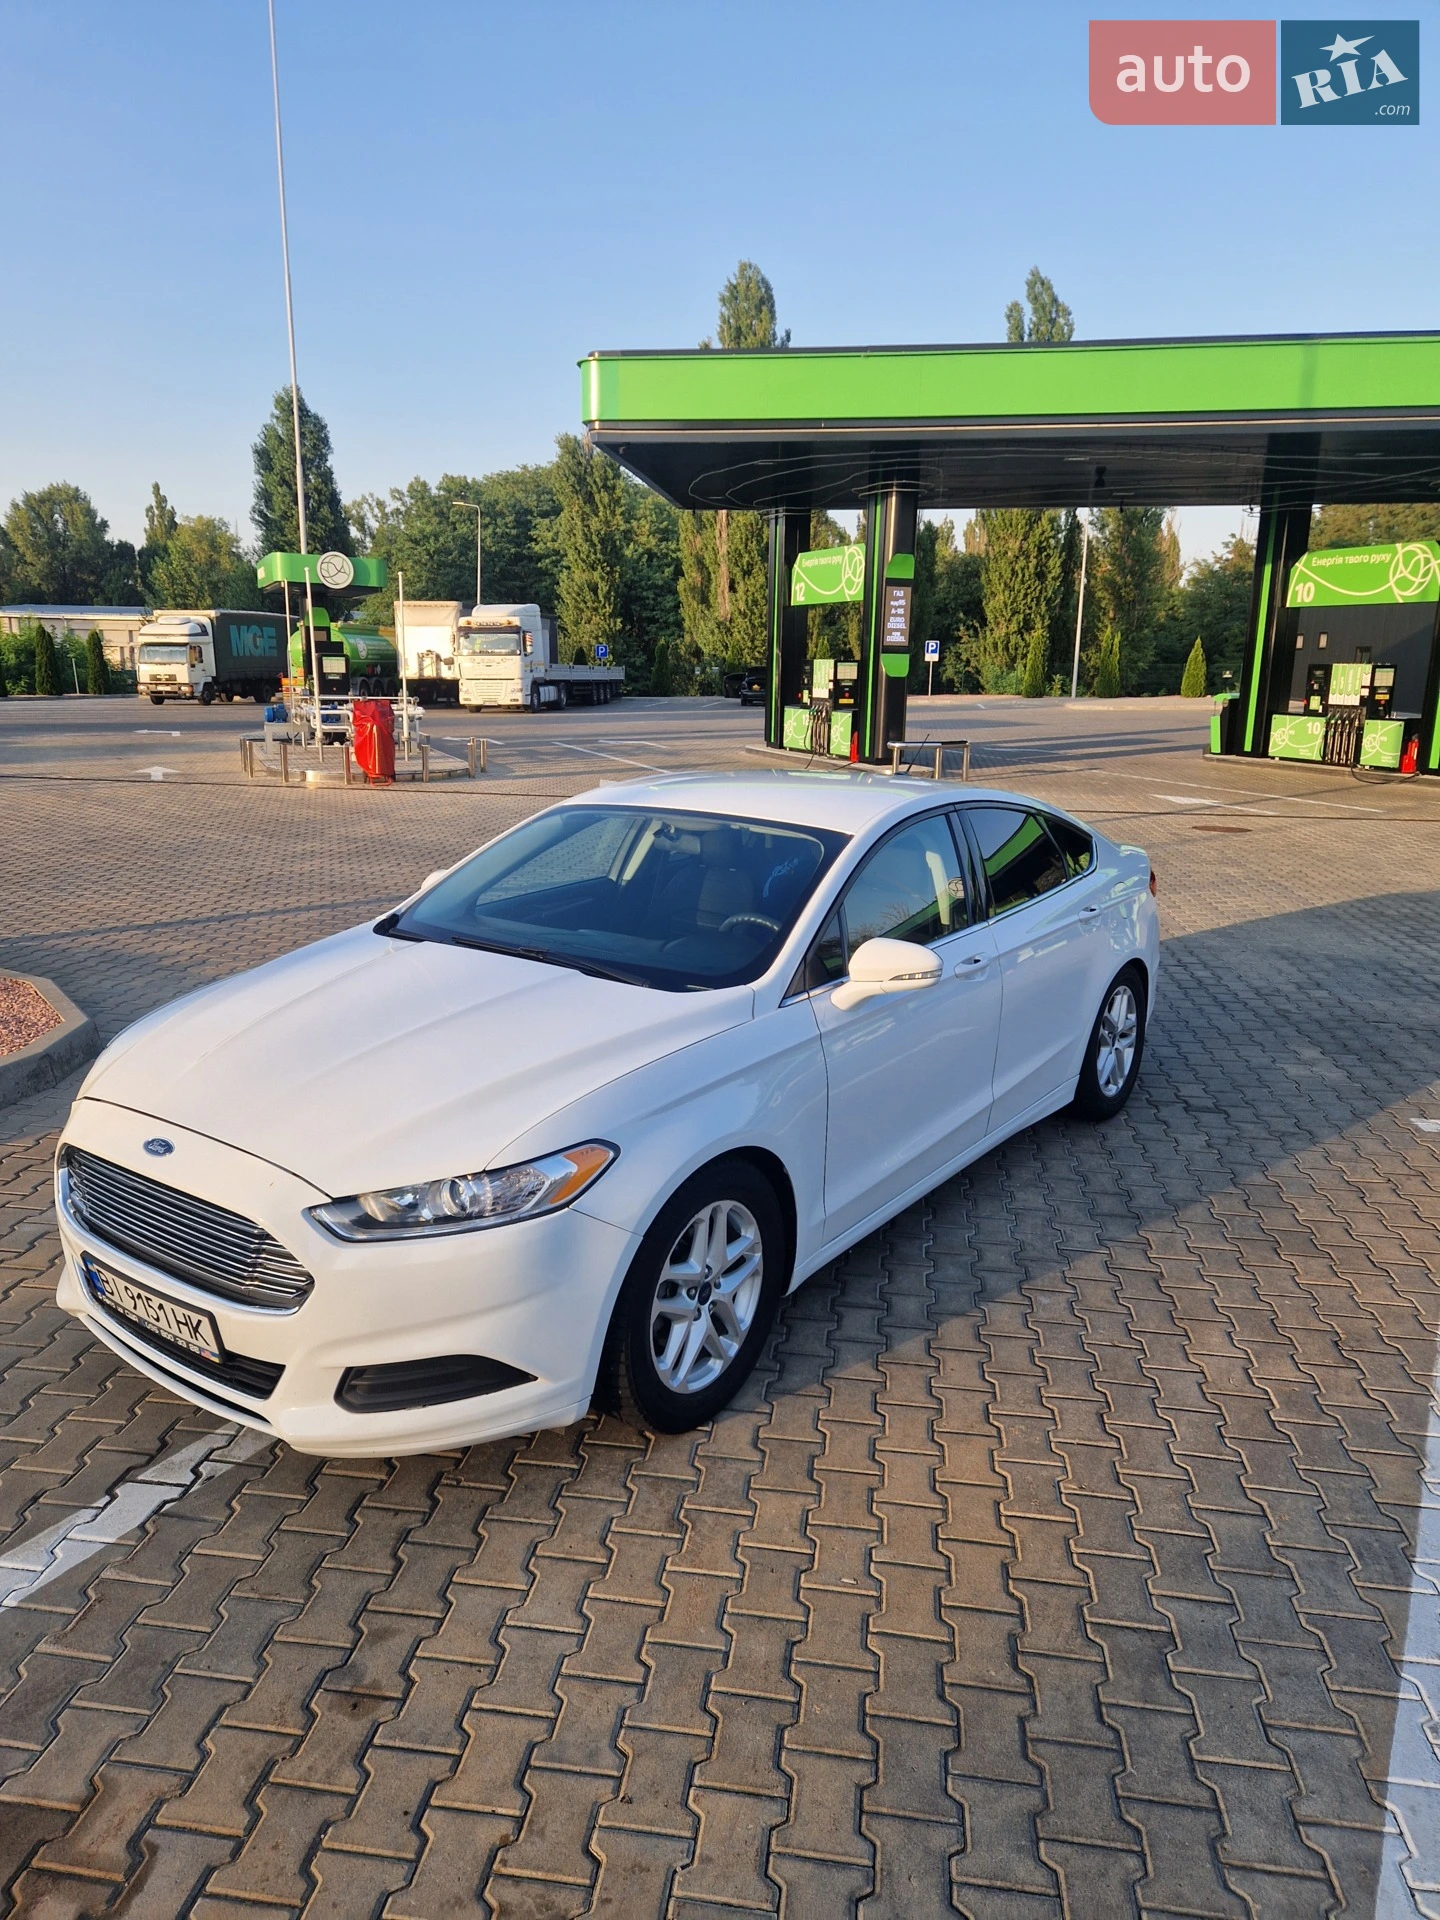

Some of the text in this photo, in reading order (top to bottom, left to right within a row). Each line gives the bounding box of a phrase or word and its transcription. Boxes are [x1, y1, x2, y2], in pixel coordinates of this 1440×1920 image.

[1311, 552, 1392, 568] Енергія твого руху
[795, 582, 806, 602] 12
[1295, 581, 1315, 603] 10
[229, 624, 278, 657] MGE
[1306, 721, 1321, 735] 10
[124, 1285, 172, 1330] 9151
[171, 1307, 211, 1347] HK
